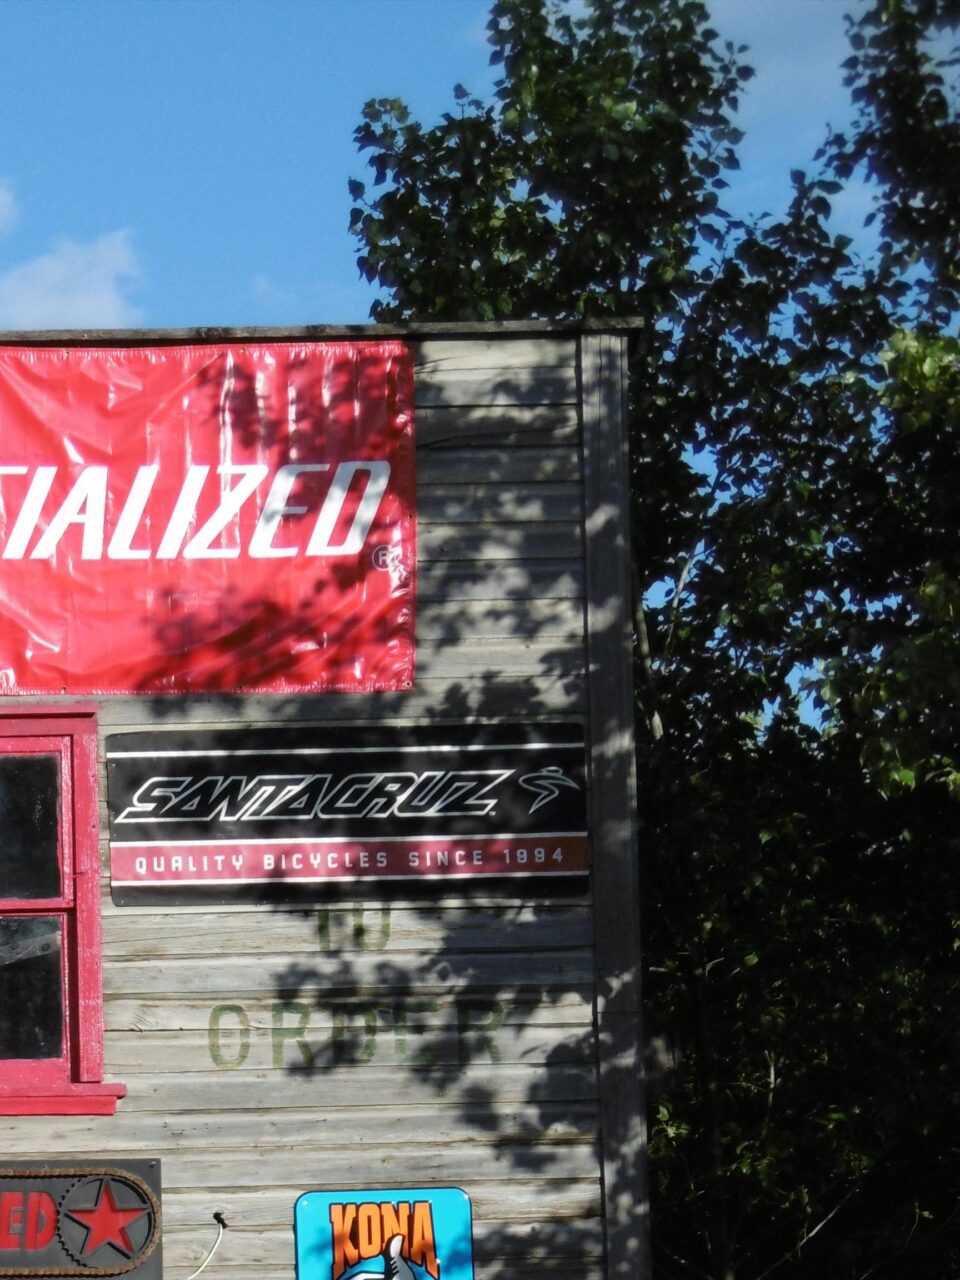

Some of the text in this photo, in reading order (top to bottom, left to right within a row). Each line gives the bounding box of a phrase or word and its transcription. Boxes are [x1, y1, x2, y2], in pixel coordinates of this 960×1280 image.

[135, 847, 565, 874] QUALITY BICYCLES SINCE 1994
[208, 1000, 505, 1069] ORDER
